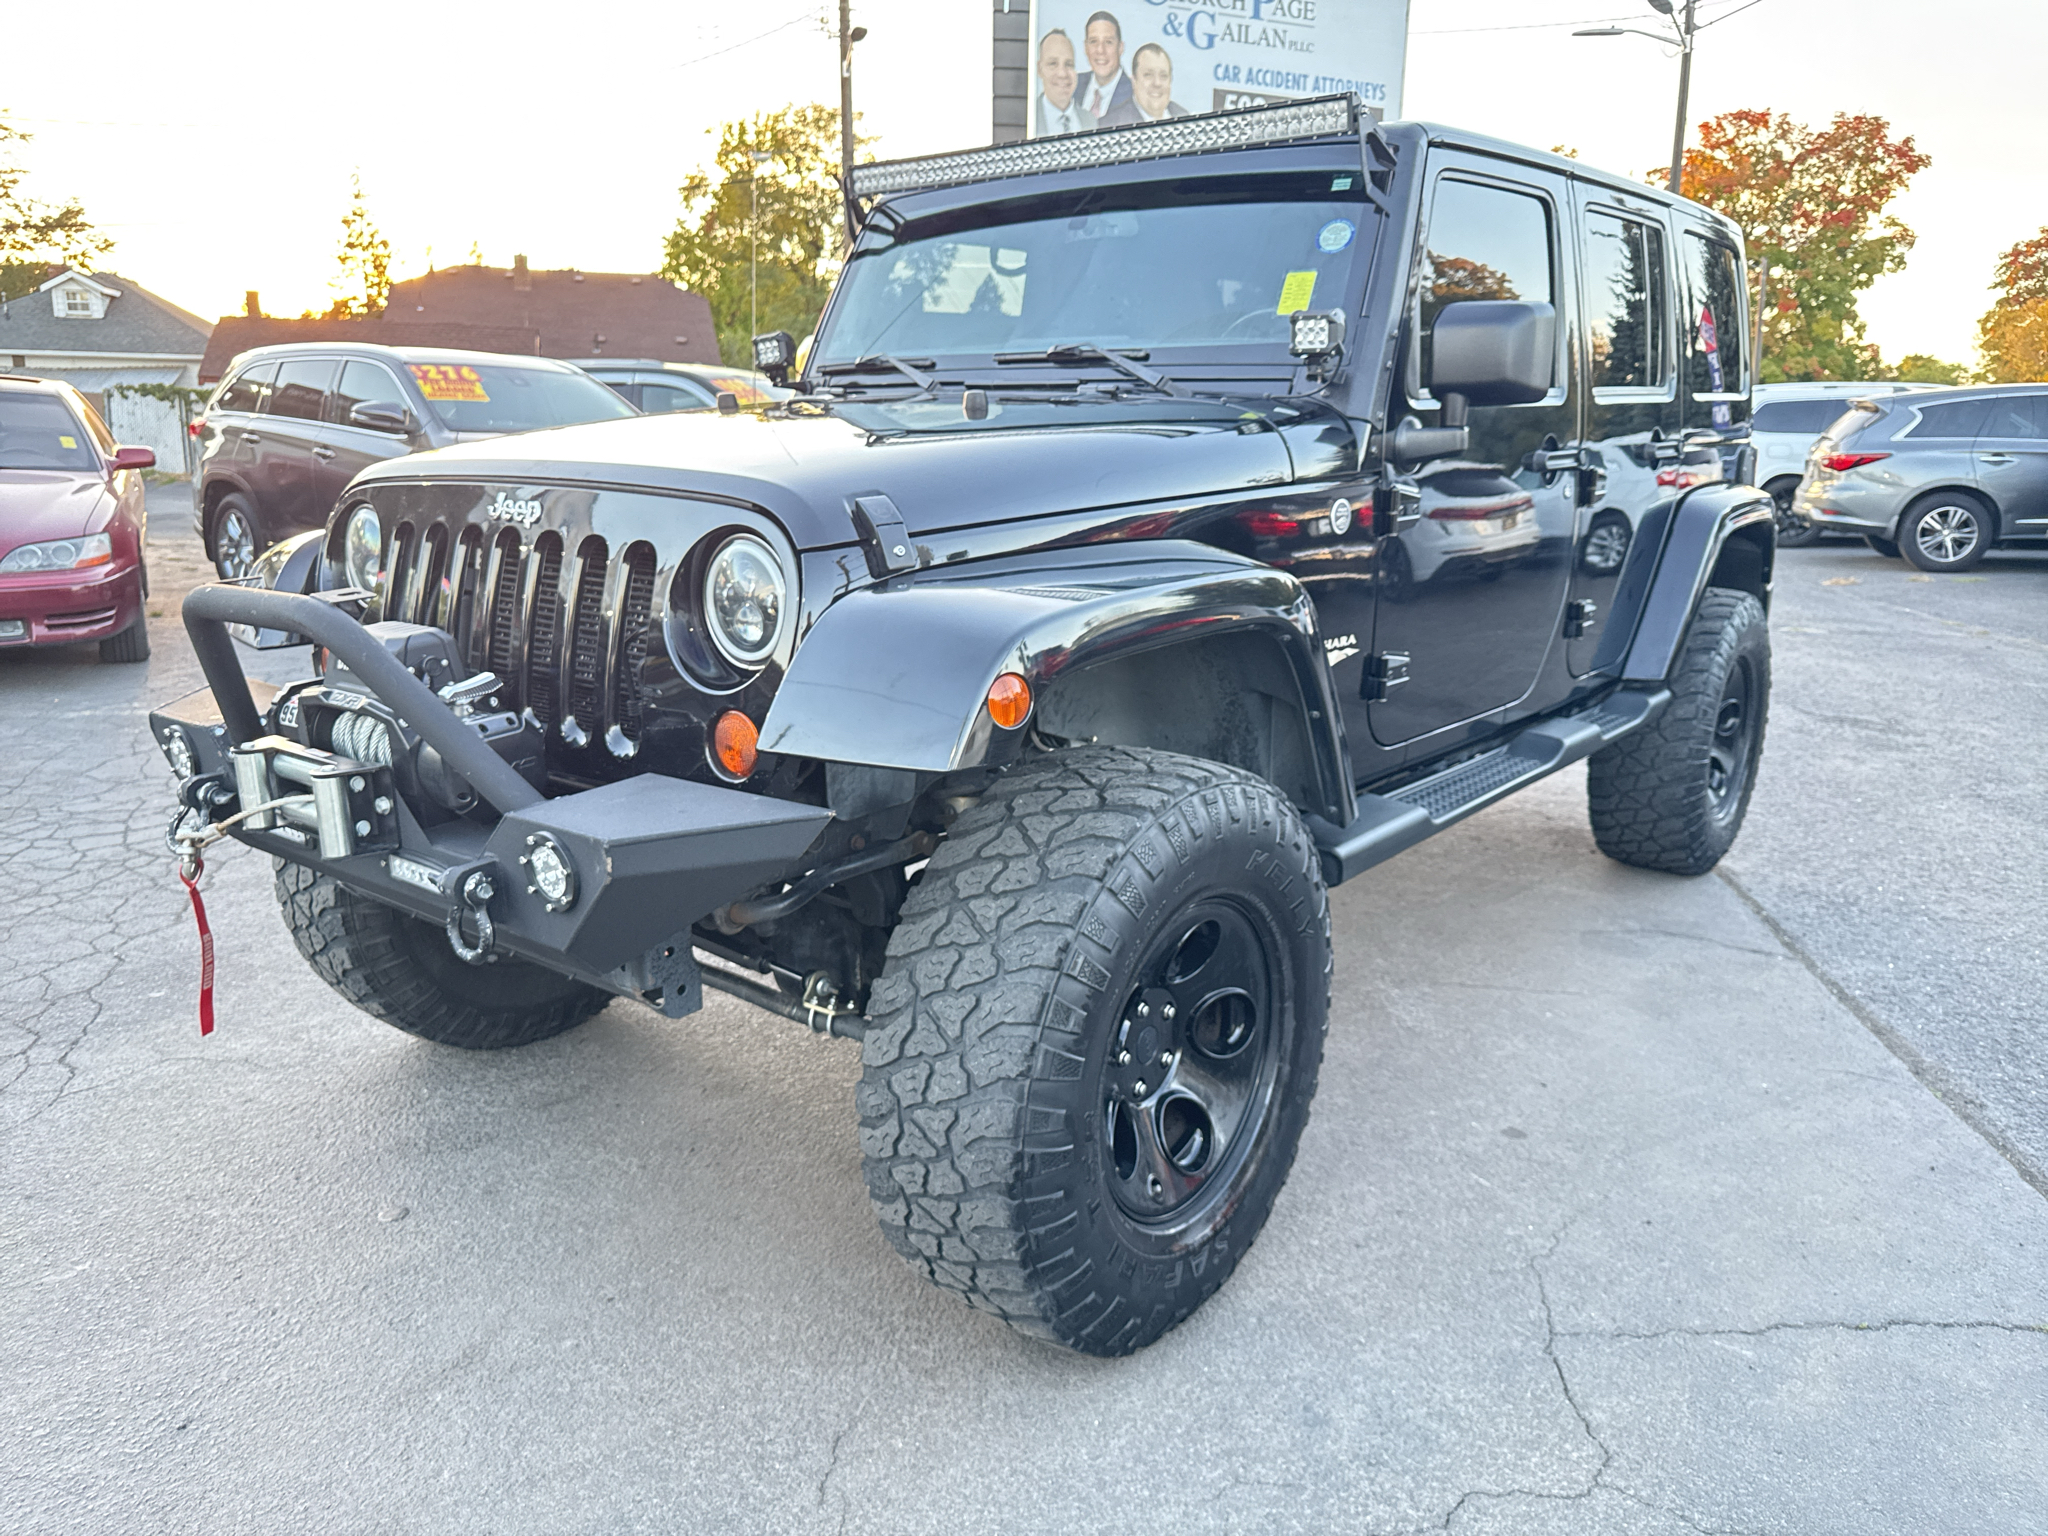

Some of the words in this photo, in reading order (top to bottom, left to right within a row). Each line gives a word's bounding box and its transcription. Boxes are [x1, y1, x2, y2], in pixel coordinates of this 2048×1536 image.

[1162, 12, 1184, 38] &
[1186, 10, 1288, 51] GAILAN
[1288, 39, 1316, 53] PLLC
[1213, 63, 1242, 83] CAR
[1245, 67, 1309, 92] ACCIDENT
[1312, 75, 1387, 102] ATTORNEYS
[487, 491, 543, 530] Jeep
[1323, 633, 1358, 651] HARA
[1244, 849, 1316, 938] KELLY
